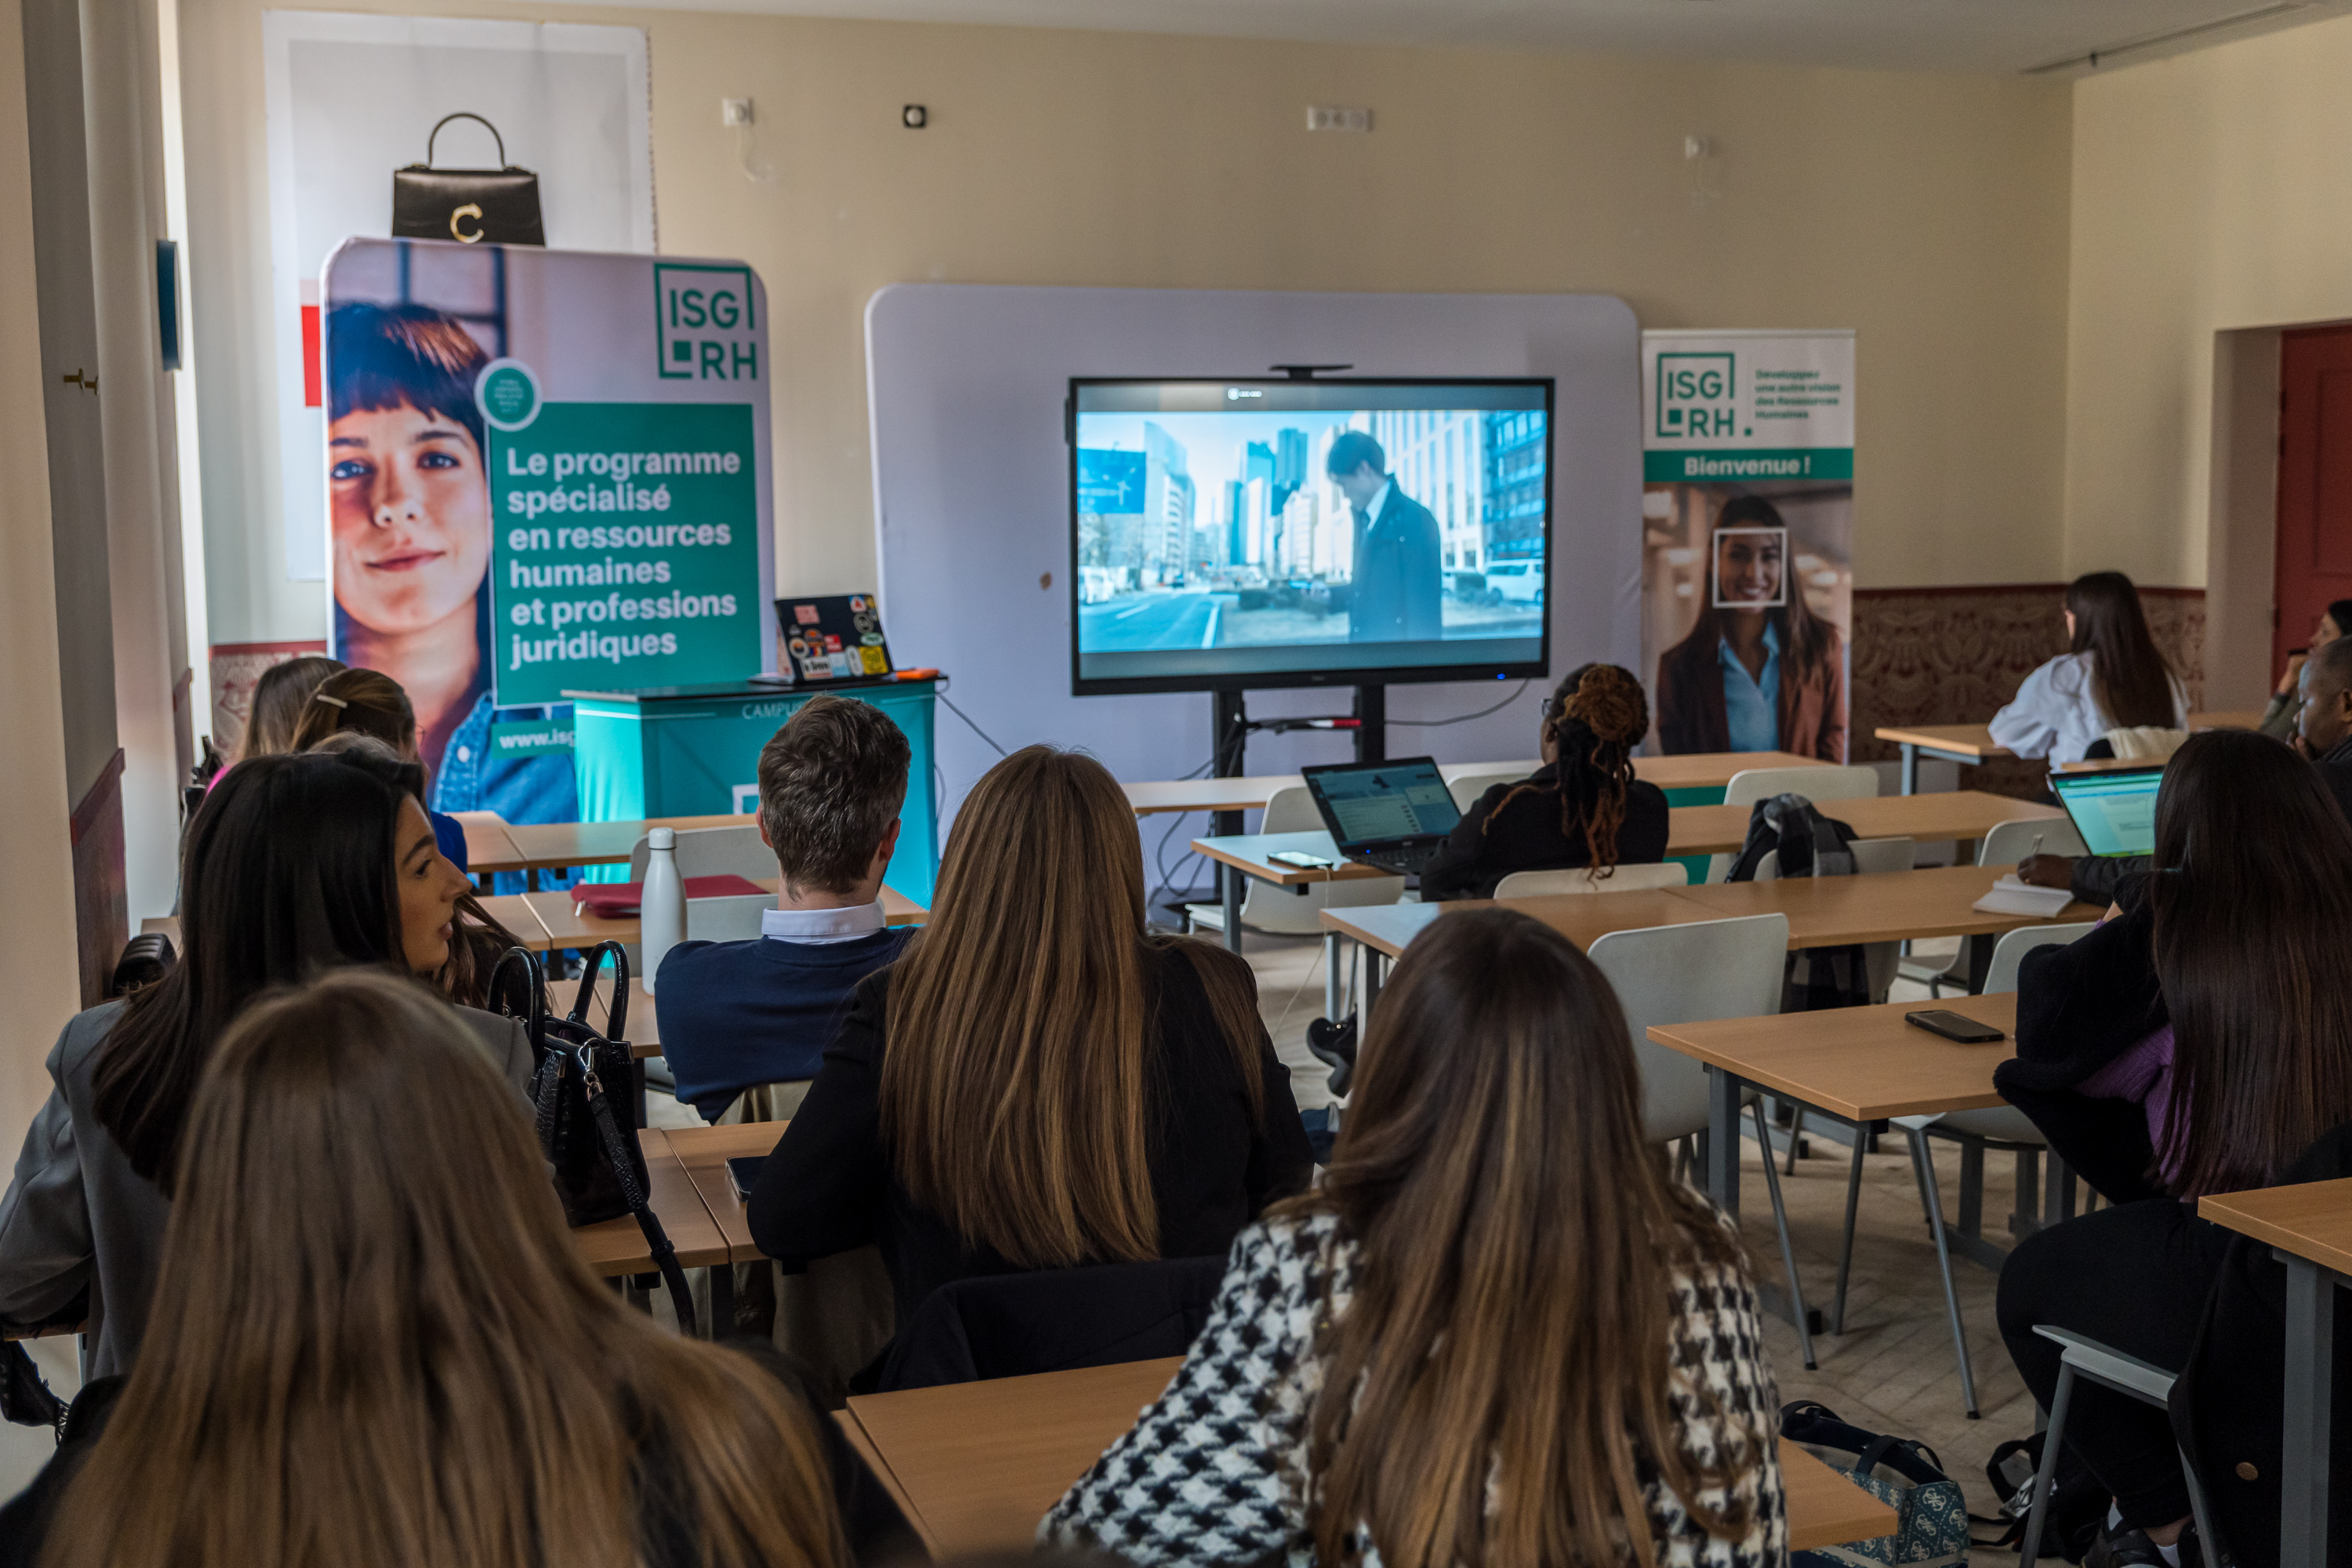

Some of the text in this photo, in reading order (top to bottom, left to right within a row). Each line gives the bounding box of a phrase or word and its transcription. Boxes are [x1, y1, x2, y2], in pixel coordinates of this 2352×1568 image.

[670, 288, 740, 330] ISG
[701, 340, 758, 380] RH
[1668, 370, 1722, 400] ISG
[507, 448, 741, 482] Le programme
[1684, 456, 1802, 477] Bienvenue
[507, 482, 671, 520] spécialisé
[508, 523, 732, 551] en ressources
[510, 556, 671, 589] humaines
[510, 590, 737, 630] et professions
[510, 630, 677, 671] juridiques
[742, 700, 801, 720] CAMPU
